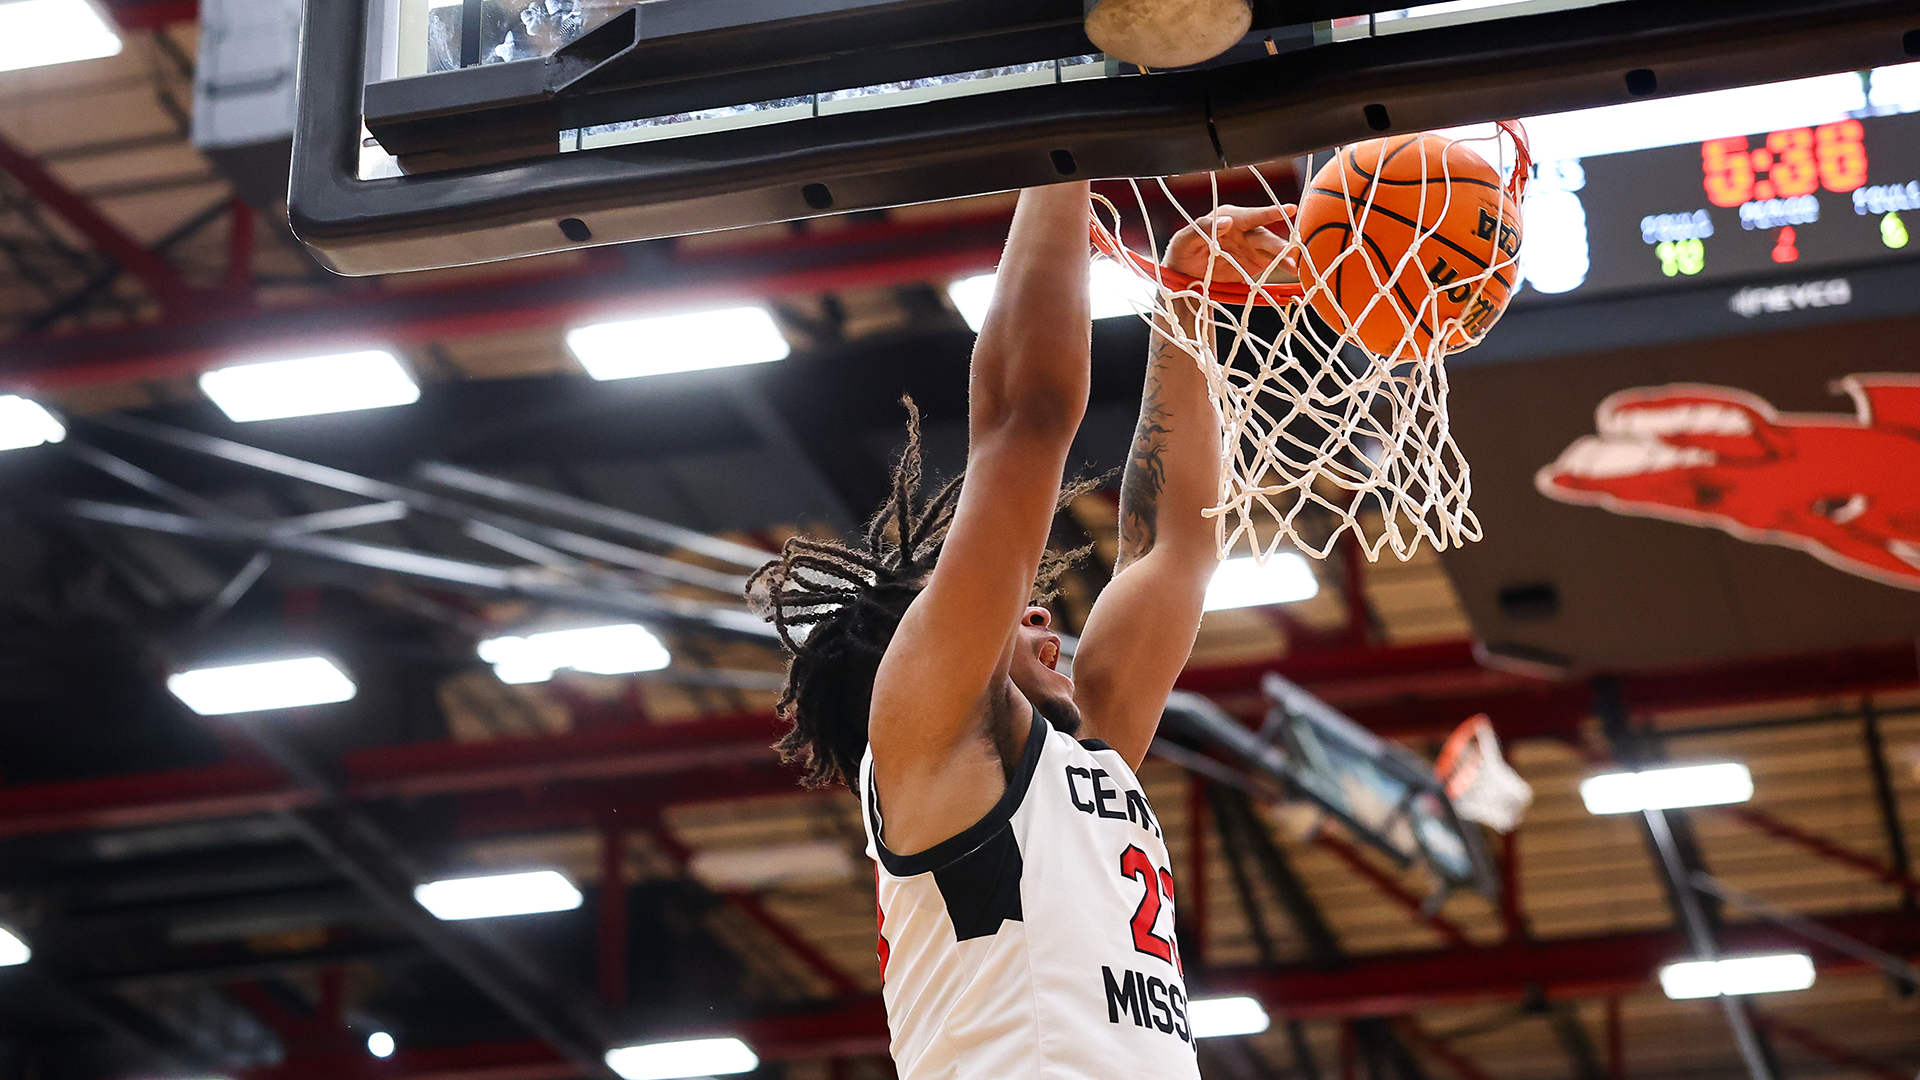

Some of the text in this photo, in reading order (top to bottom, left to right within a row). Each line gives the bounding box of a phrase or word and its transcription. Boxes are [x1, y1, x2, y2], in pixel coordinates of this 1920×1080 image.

[1702, 119, 1868, 208] 5:36
[1655, 238, 1706, 277] 10
[1102, 966, 1197, 1053] MISS
